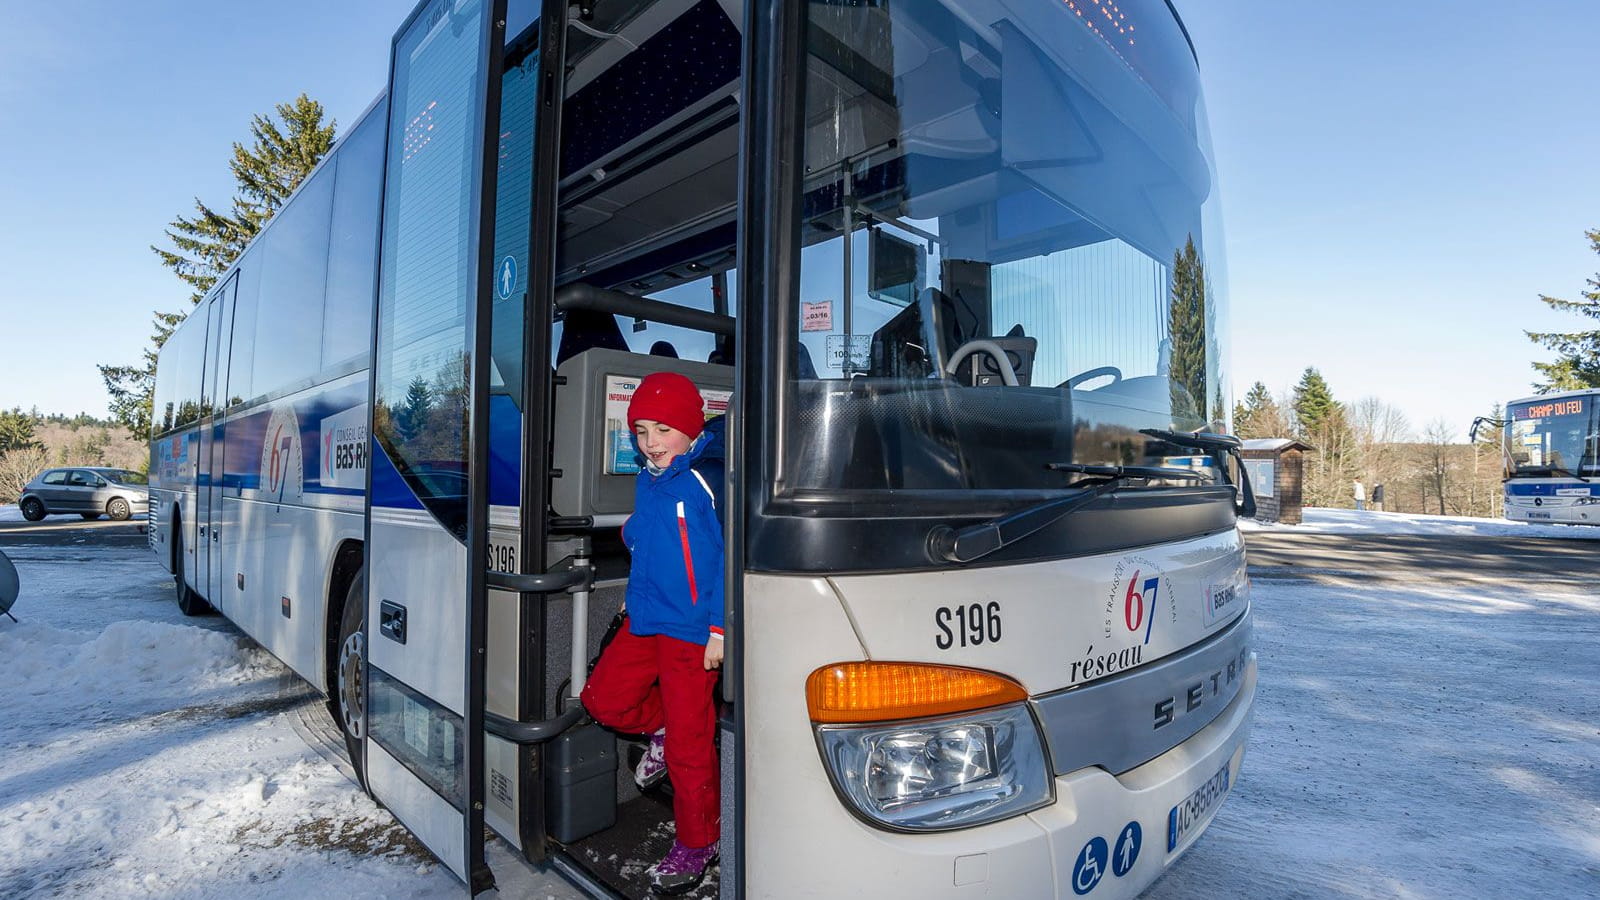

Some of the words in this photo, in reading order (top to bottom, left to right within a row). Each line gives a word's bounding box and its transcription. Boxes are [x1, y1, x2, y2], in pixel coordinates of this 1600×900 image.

[810, 312, 828, 320] 03/16
[1528, 404, 1554, 419] CHAMP
[1554, 402, 1566, 416] DU
[1566, 400, 1582, 414] FEU
[487, 544, 515, 574] S196
[935, 600, 1002, 650] S196
[1125, 569, 1160, 645] 67
[1070, 644, 1143, 683] réseau
[1153, 646, 1247, 731] SETRA
